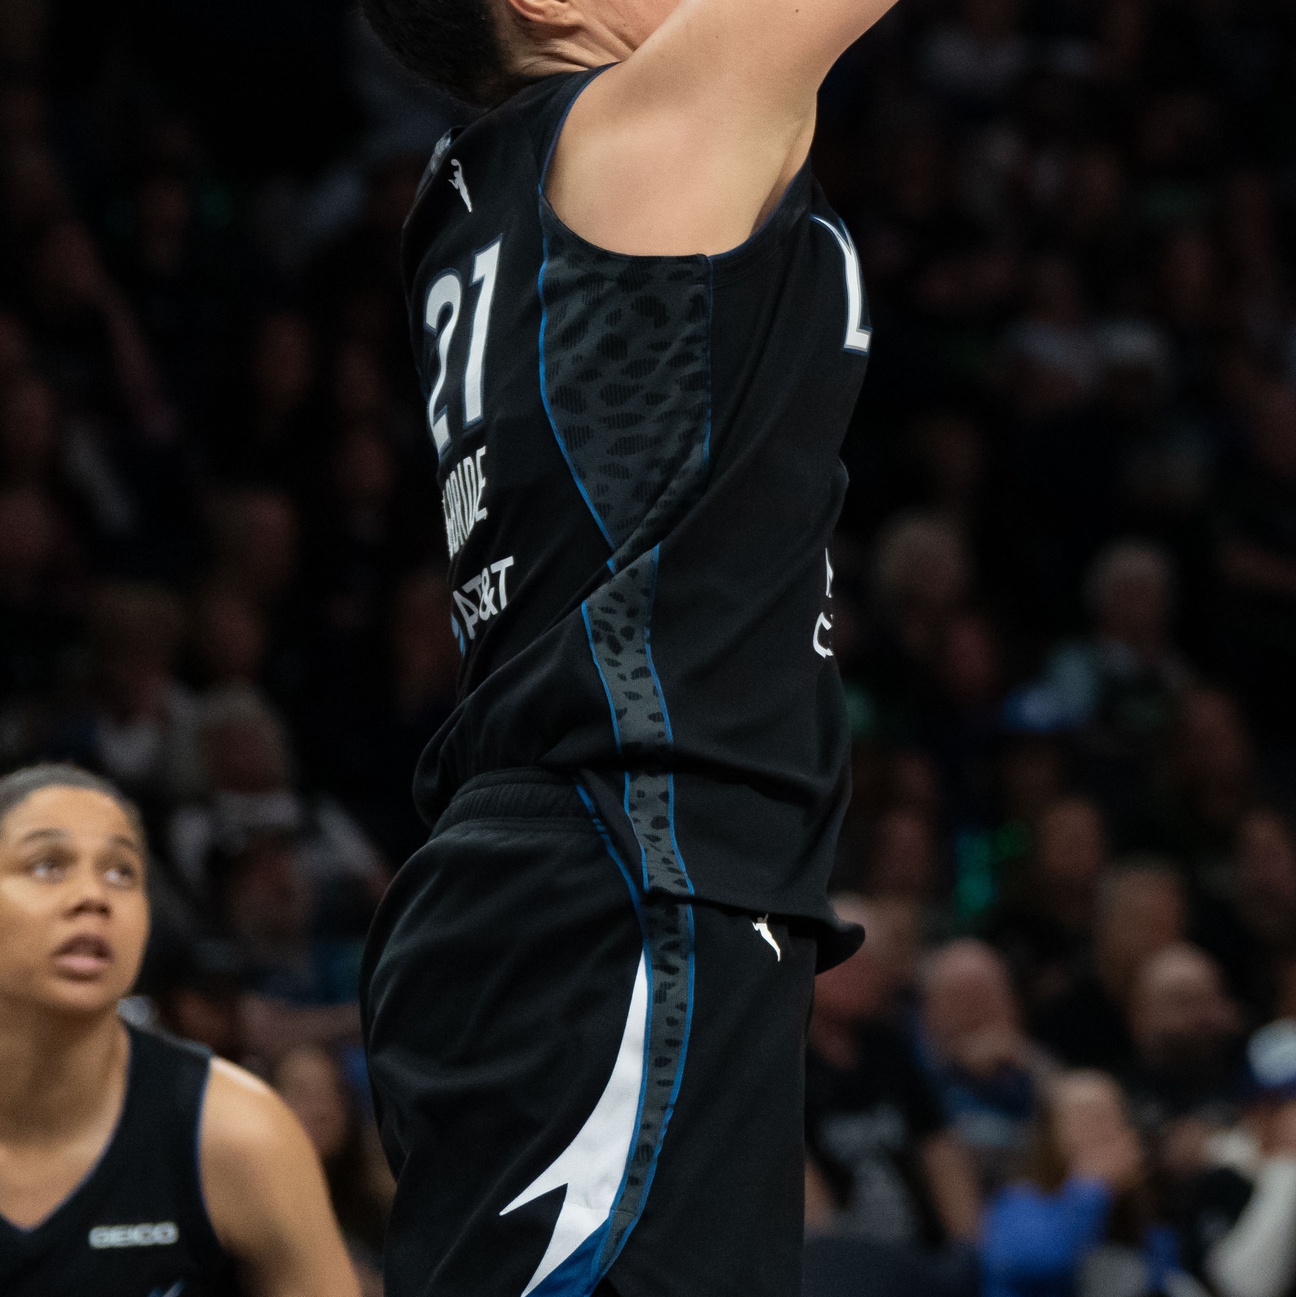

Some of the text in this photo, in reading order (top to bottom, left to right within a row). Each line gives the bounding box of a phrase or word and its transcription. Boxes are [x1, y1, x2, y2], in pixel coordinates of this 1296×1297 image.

[424, 232, 502, 459] 21
[442, 445, 489, 561] BRIDE
[452, 555, 515, 640] AT&T
[88, 1222, 179, 1249] GEICO
